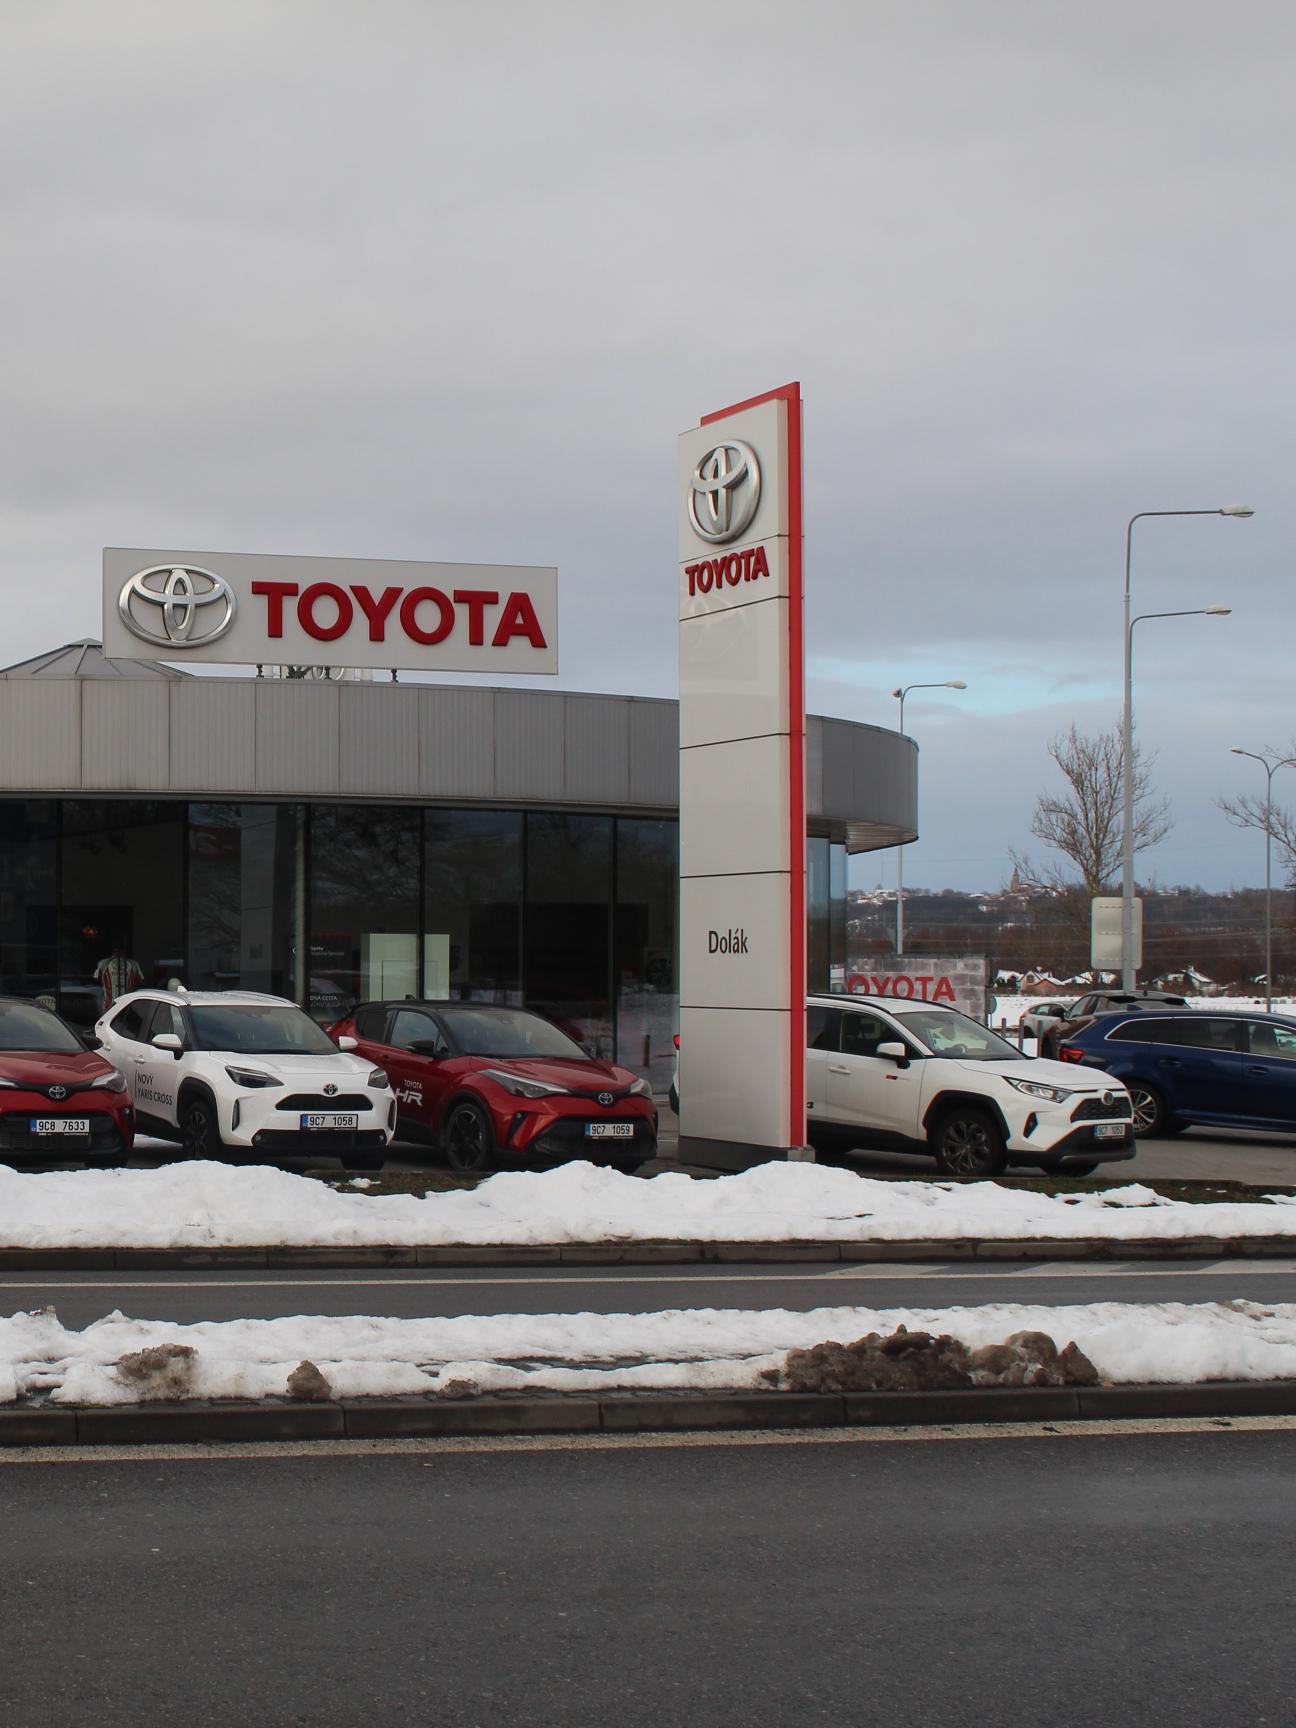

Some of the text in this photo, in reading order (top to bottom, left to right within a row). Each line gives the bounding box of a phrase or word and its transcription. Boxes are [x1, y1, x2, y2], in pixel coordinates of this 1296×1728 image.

[685, 546, 770, 597] TOYOTA
[252, 581, 547, 648] TOYOTA
[708, 928, 748, 954] Dolák
[847, 976, 956, 1002] OYOTA
[404, 1079, 423, 1090] TOYOTA
[137, 1087, 173, 1106] YARIS CROSS
[395, 1088, 423, 1107] HR
[38, 1121, 86, 1131] 9C8 7633
[309, 1116, 353, 1126] 9C7 1058
[591, 1125, 630, 1135] 9C7 1059
